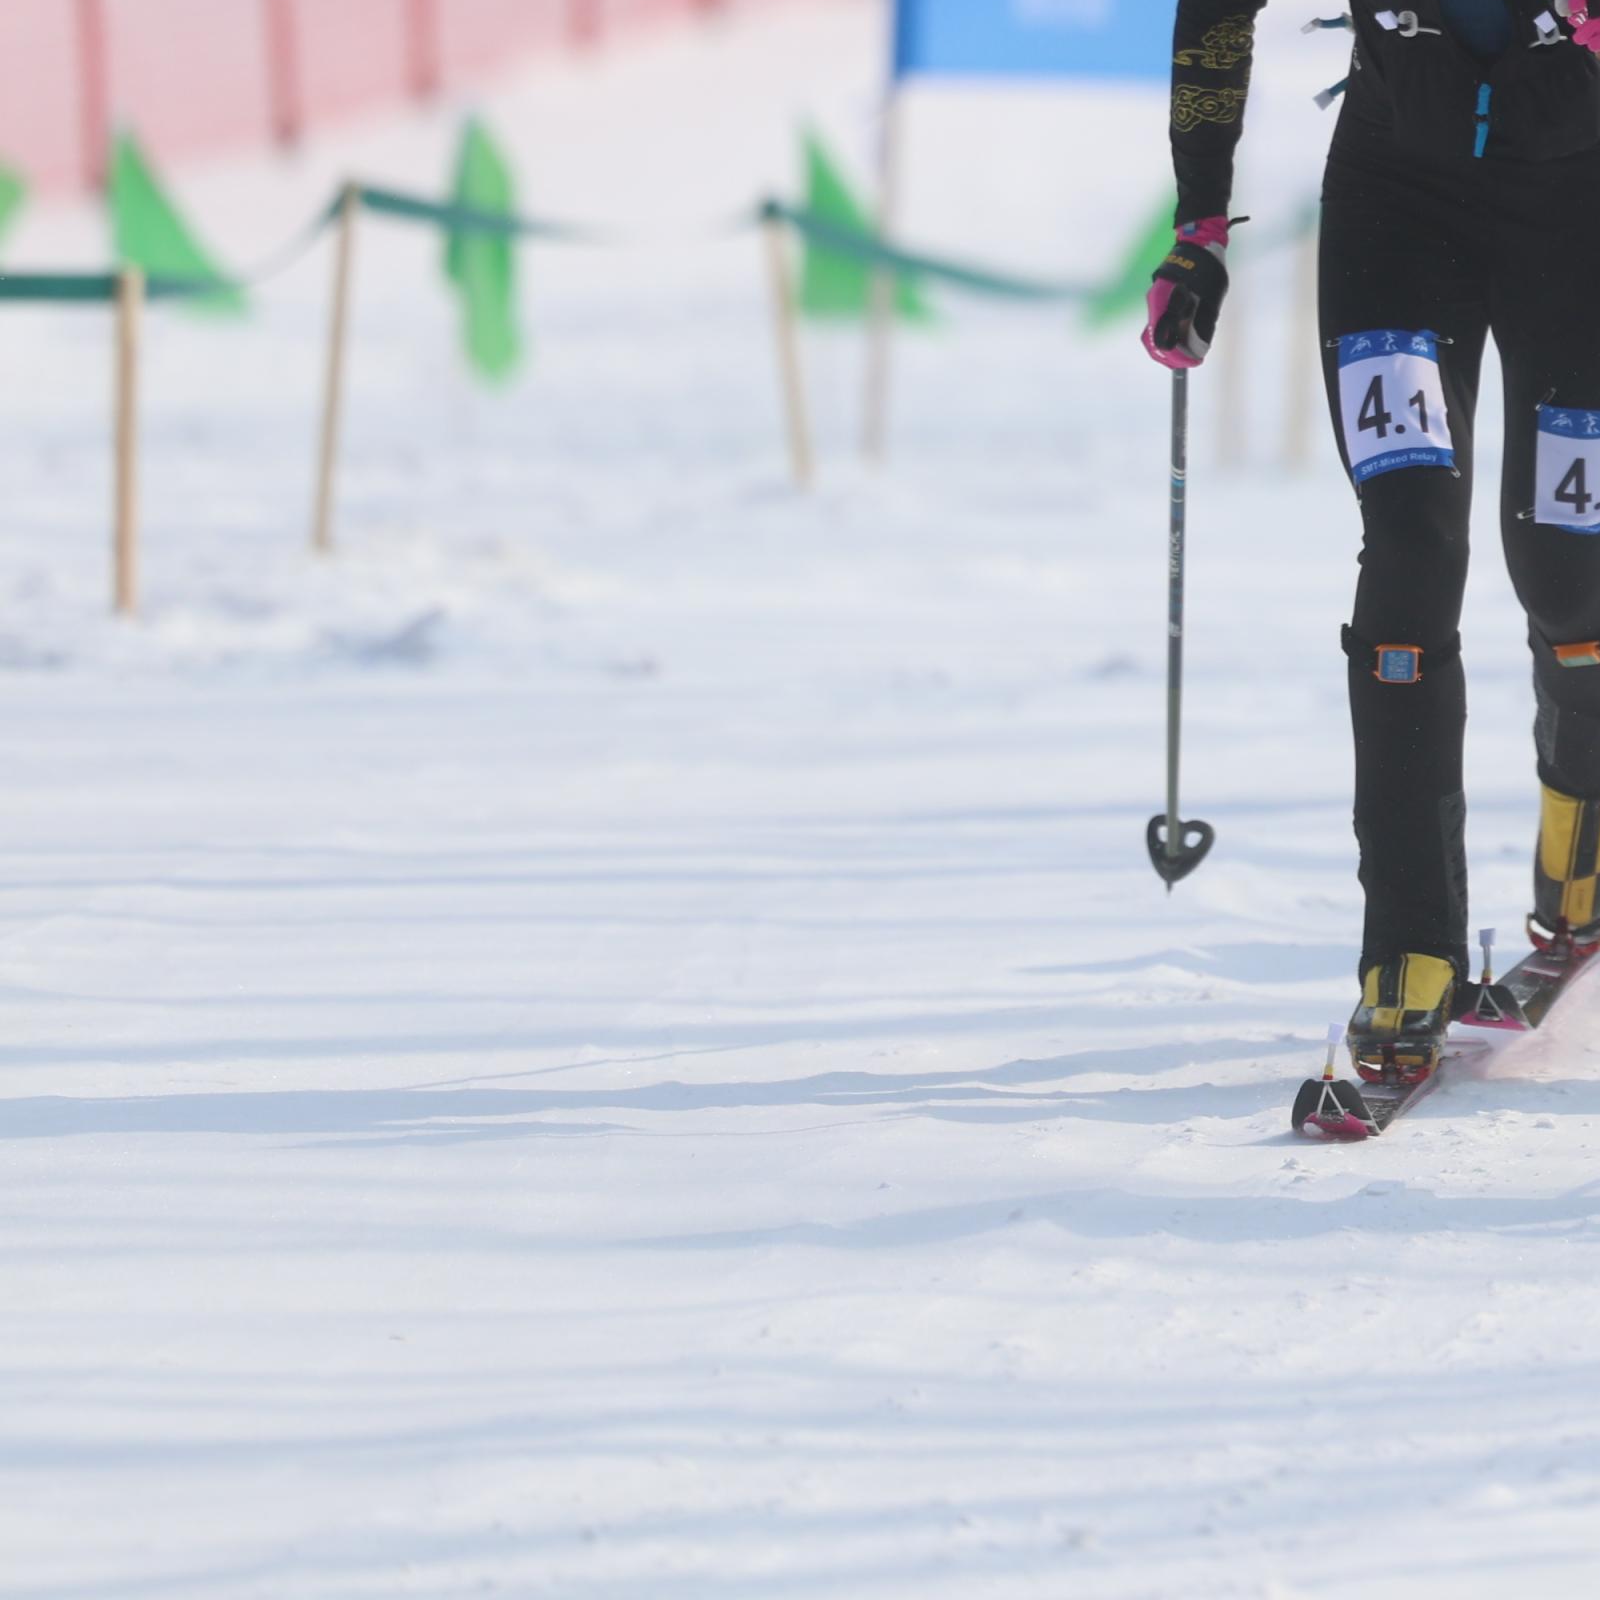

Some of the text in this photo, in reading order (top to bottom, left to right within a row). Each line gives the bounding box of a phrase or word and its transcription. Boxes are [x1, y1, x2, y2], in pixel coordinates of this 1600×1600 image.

[1357, 374, 1429, 439] 4.1
[1361, 453, 1438, 476] SMT-Mixed Relay
